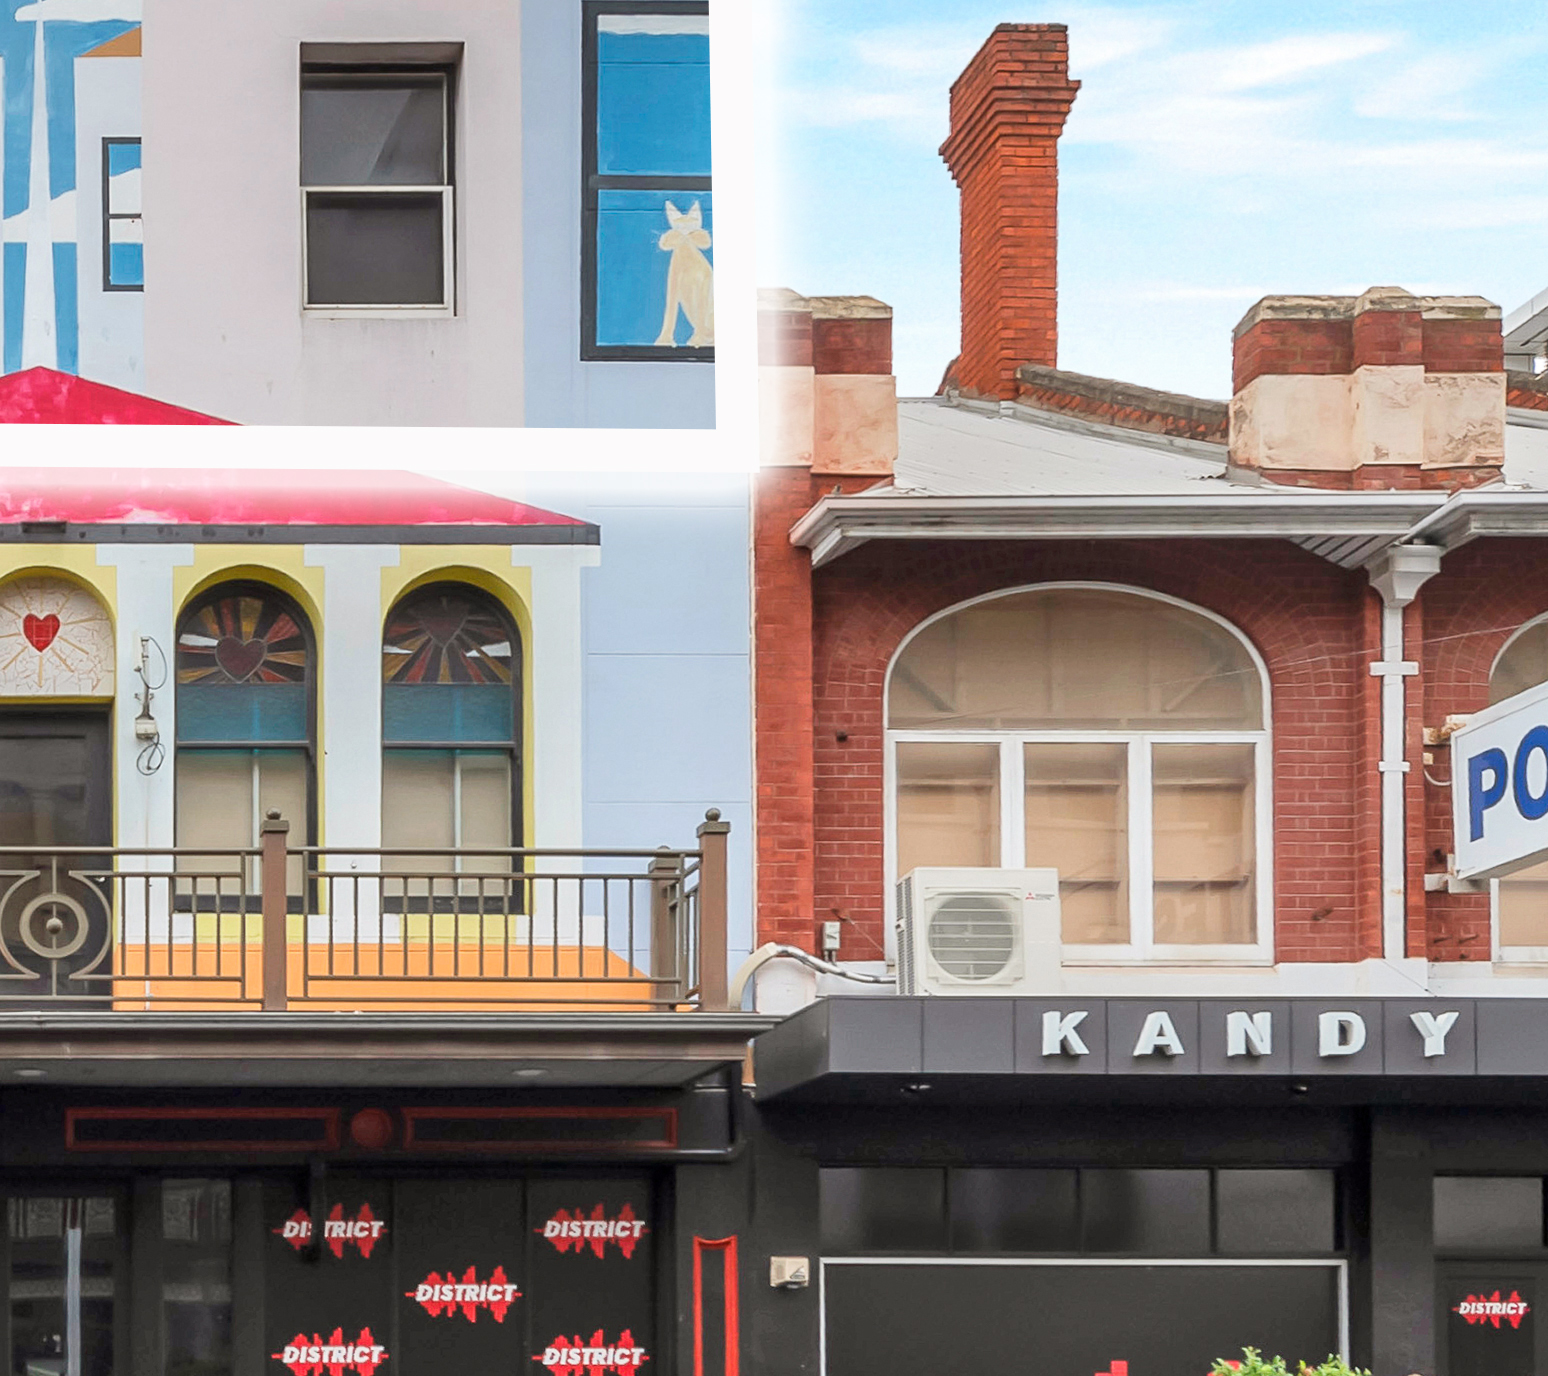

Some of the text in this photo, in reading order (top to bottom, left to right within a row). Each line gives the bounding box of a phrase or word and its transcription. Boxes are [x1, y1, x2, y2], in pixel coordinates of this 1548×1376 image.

[1041, 1010, 1460, 1058] KANDY
[543, 1219, 647, 1238] DISTRICT
[415, 1283, 518, 1302] DISTRICT
[1458, 1301, 1528, 1315] DISTRICT
[282, 1345, 385, 1365] DISTRICT
[541, 1347, 646, 1366] DISTRICT
